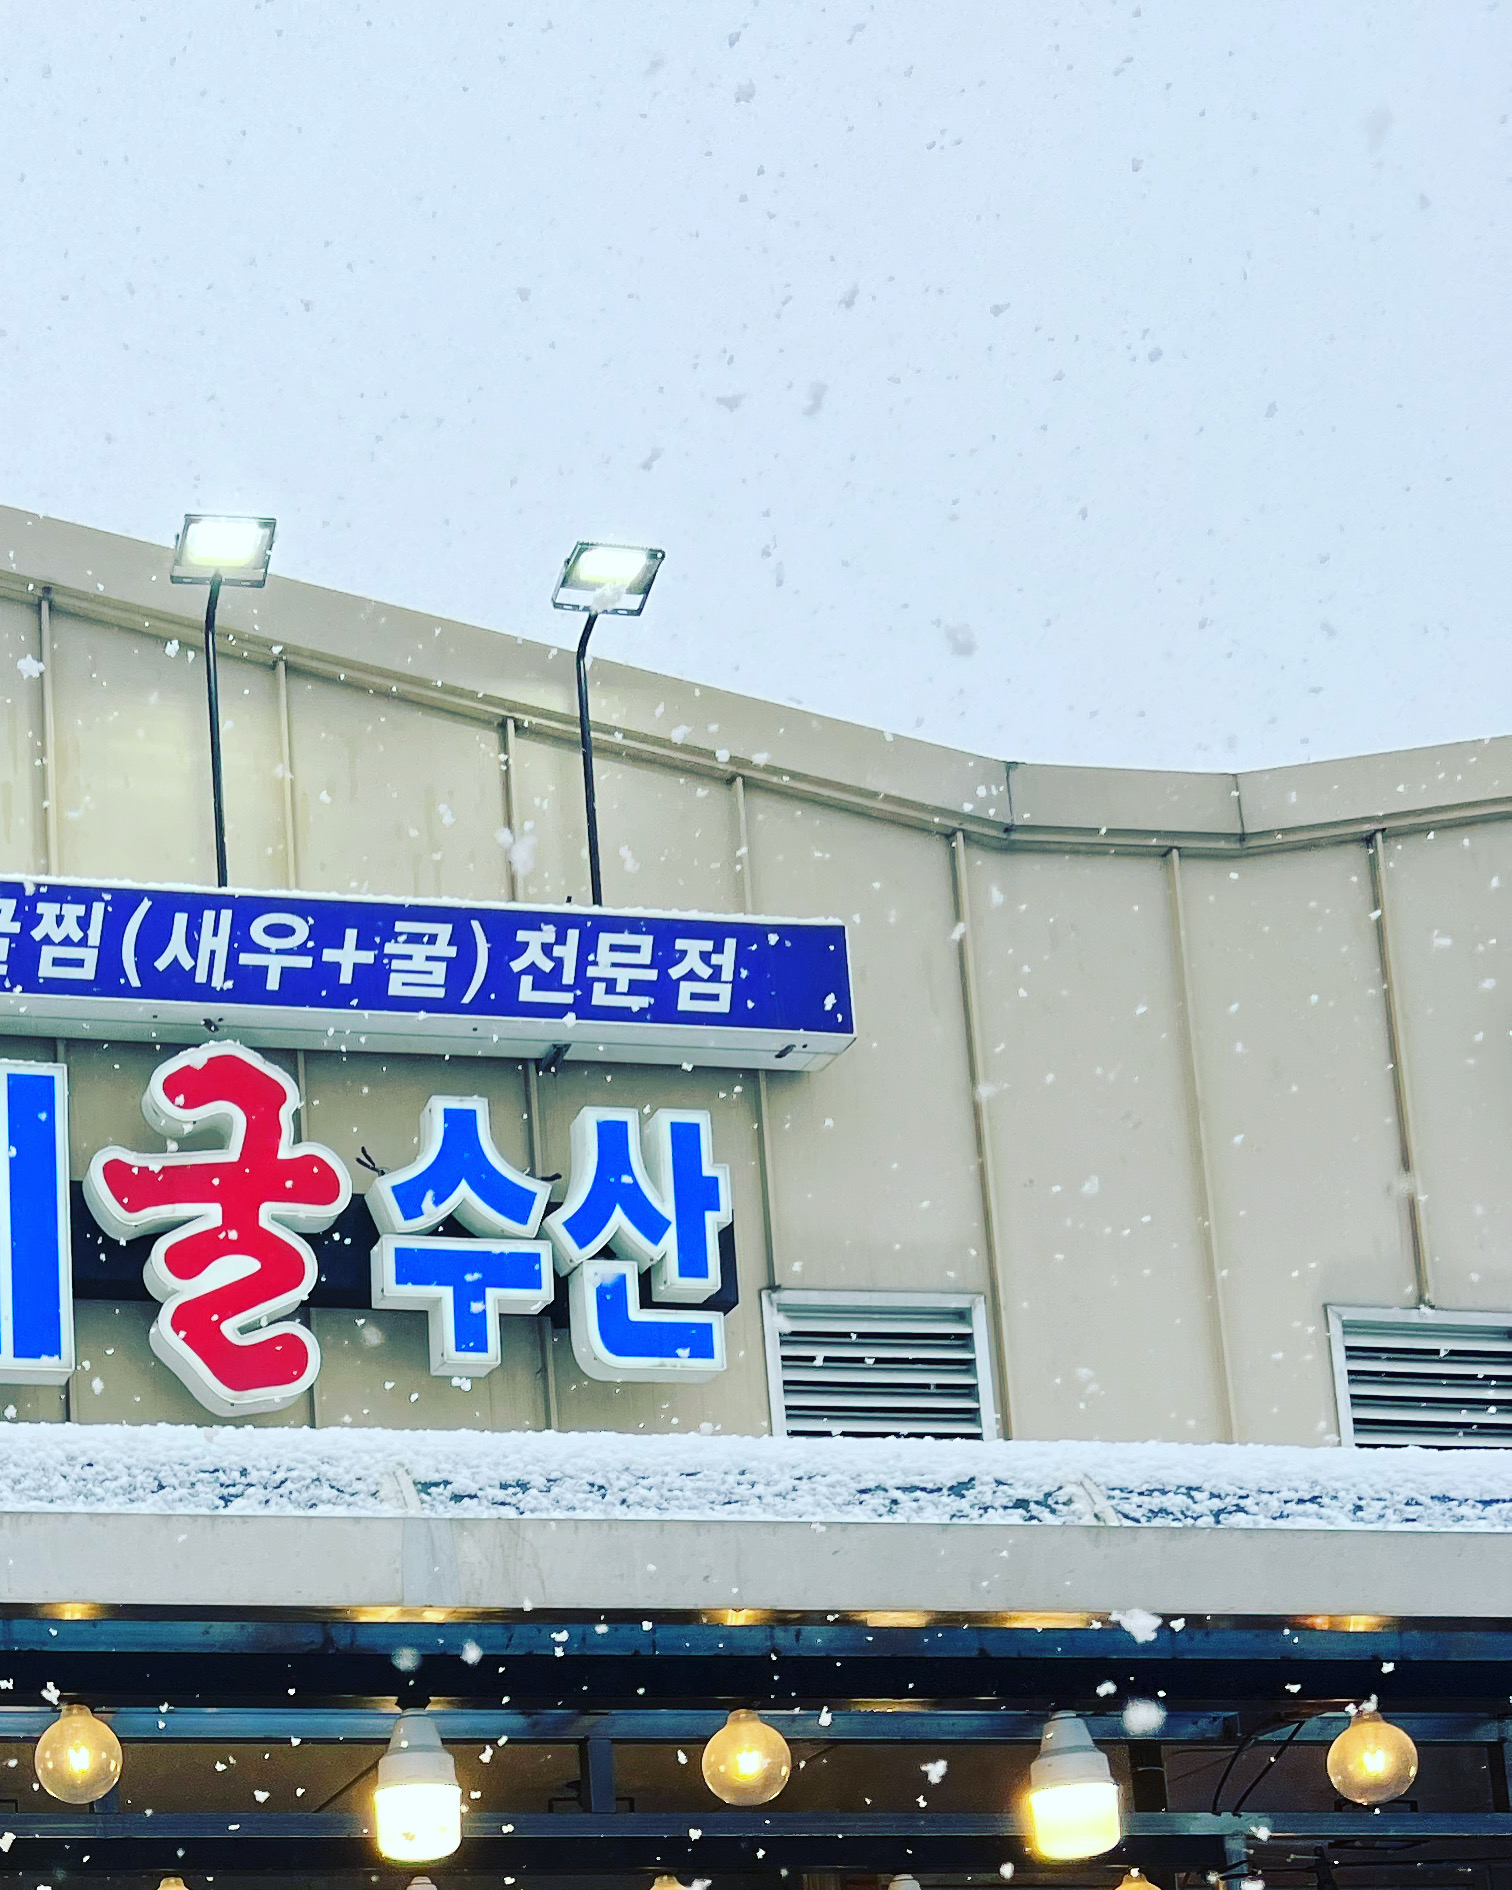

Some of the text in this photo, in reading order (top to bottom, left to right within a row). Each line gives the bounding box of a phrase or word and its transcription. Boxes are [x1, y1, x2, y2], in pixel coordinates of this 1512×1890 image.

[507, 922, 740, 1014] 전문점
[82, 1040, 353, 1418] 굴
[365, 1094, 733, 1384] 수산
